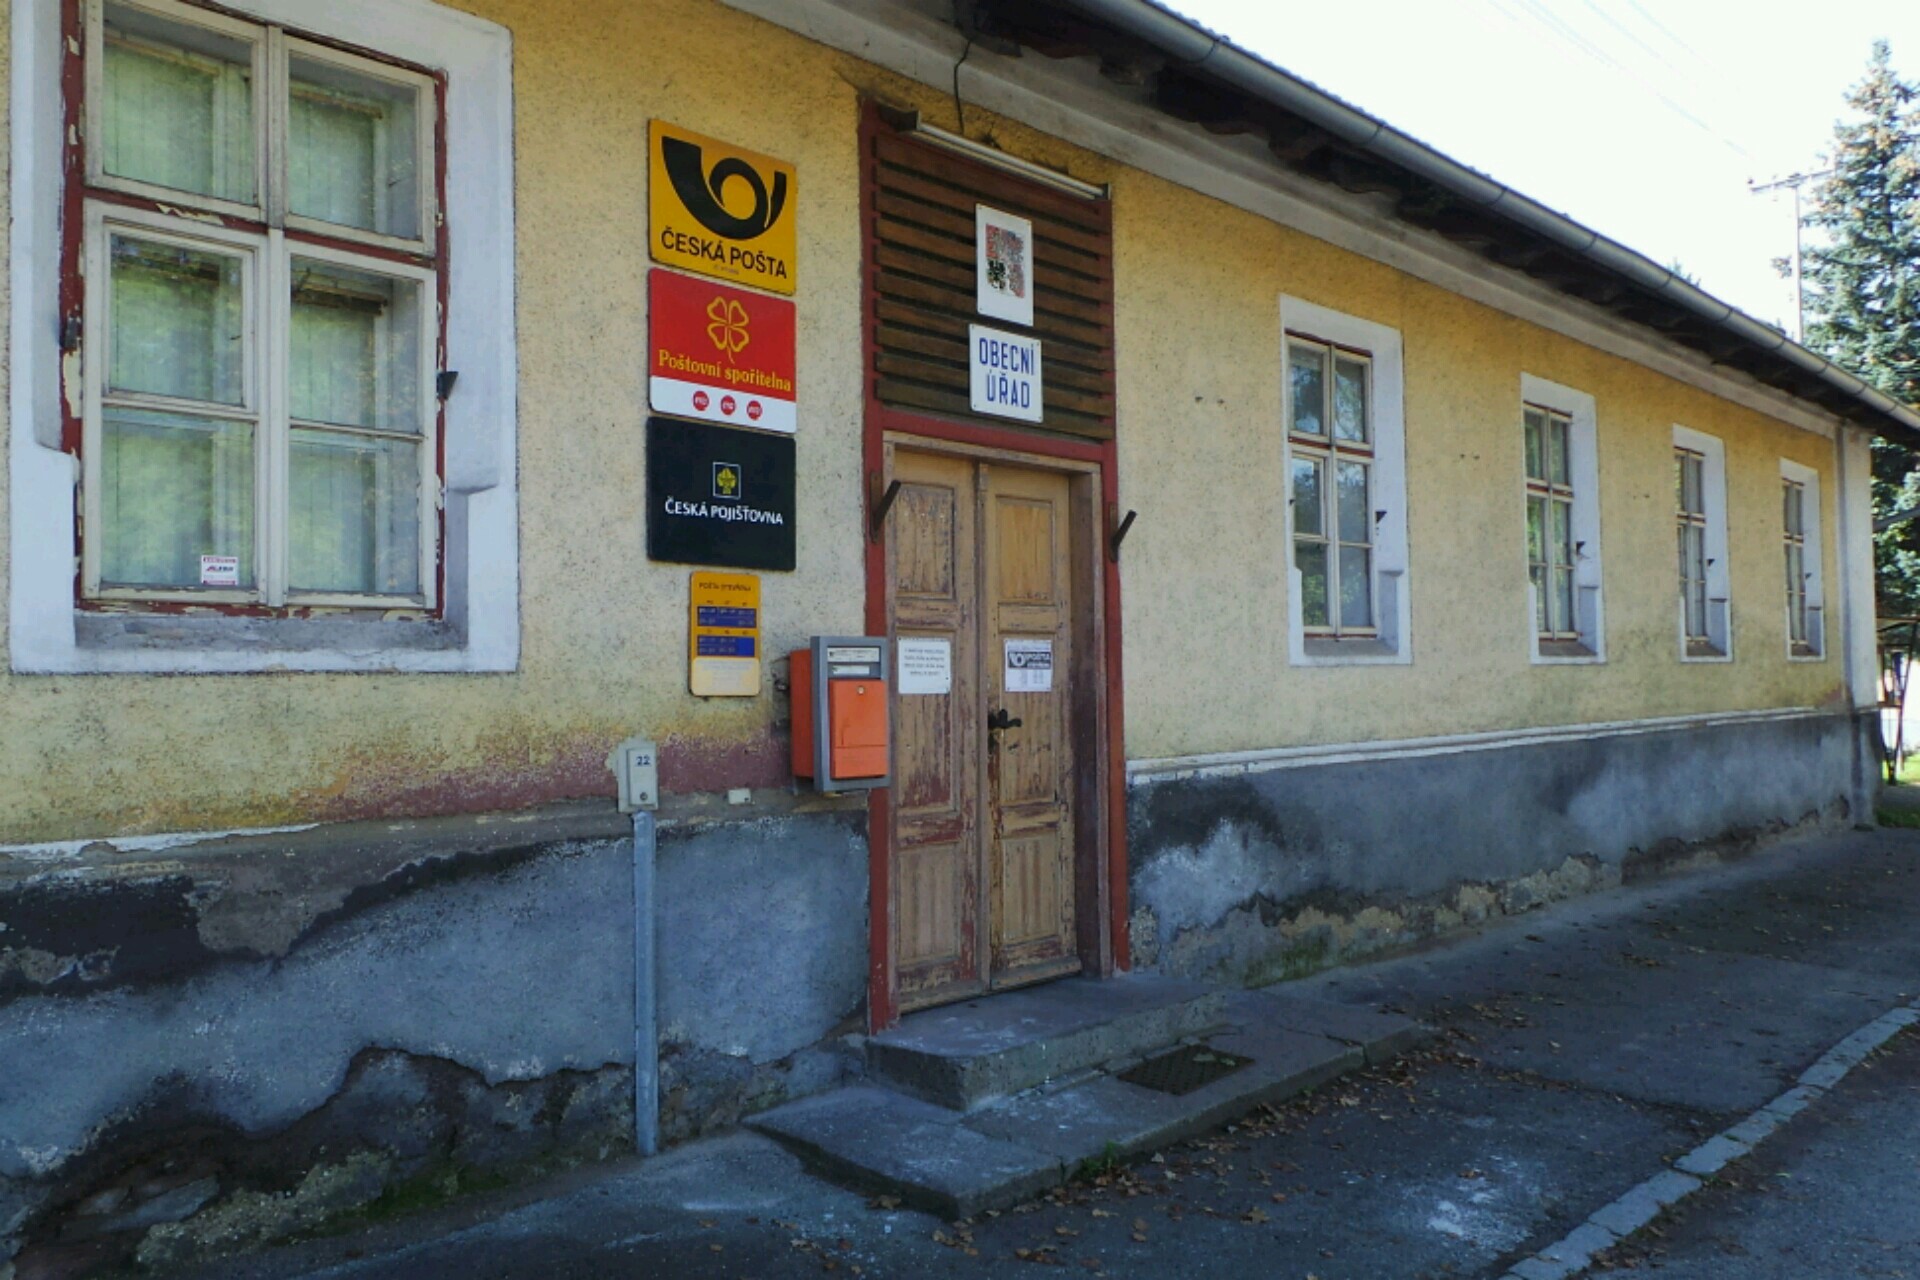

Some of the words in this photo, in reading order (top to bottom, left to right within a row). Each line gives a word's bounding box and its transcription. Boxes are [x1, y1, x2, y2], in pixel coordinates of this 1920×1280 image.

[661, 225, 726, 263] ČESKÁ
[730, 247, 787, 279] POŠTA
[658, 349, 722, 378] Poštovní
[724, 367, 792, 392] spořitelna
[979, 336, 1034, 376] OBECNÍ
[987, 368, 1031, 409] ÚŘAD
[664, 495, 708, 518] ČESKÁ
[710, 505, 784, 525] POJIŠŤOVNA
